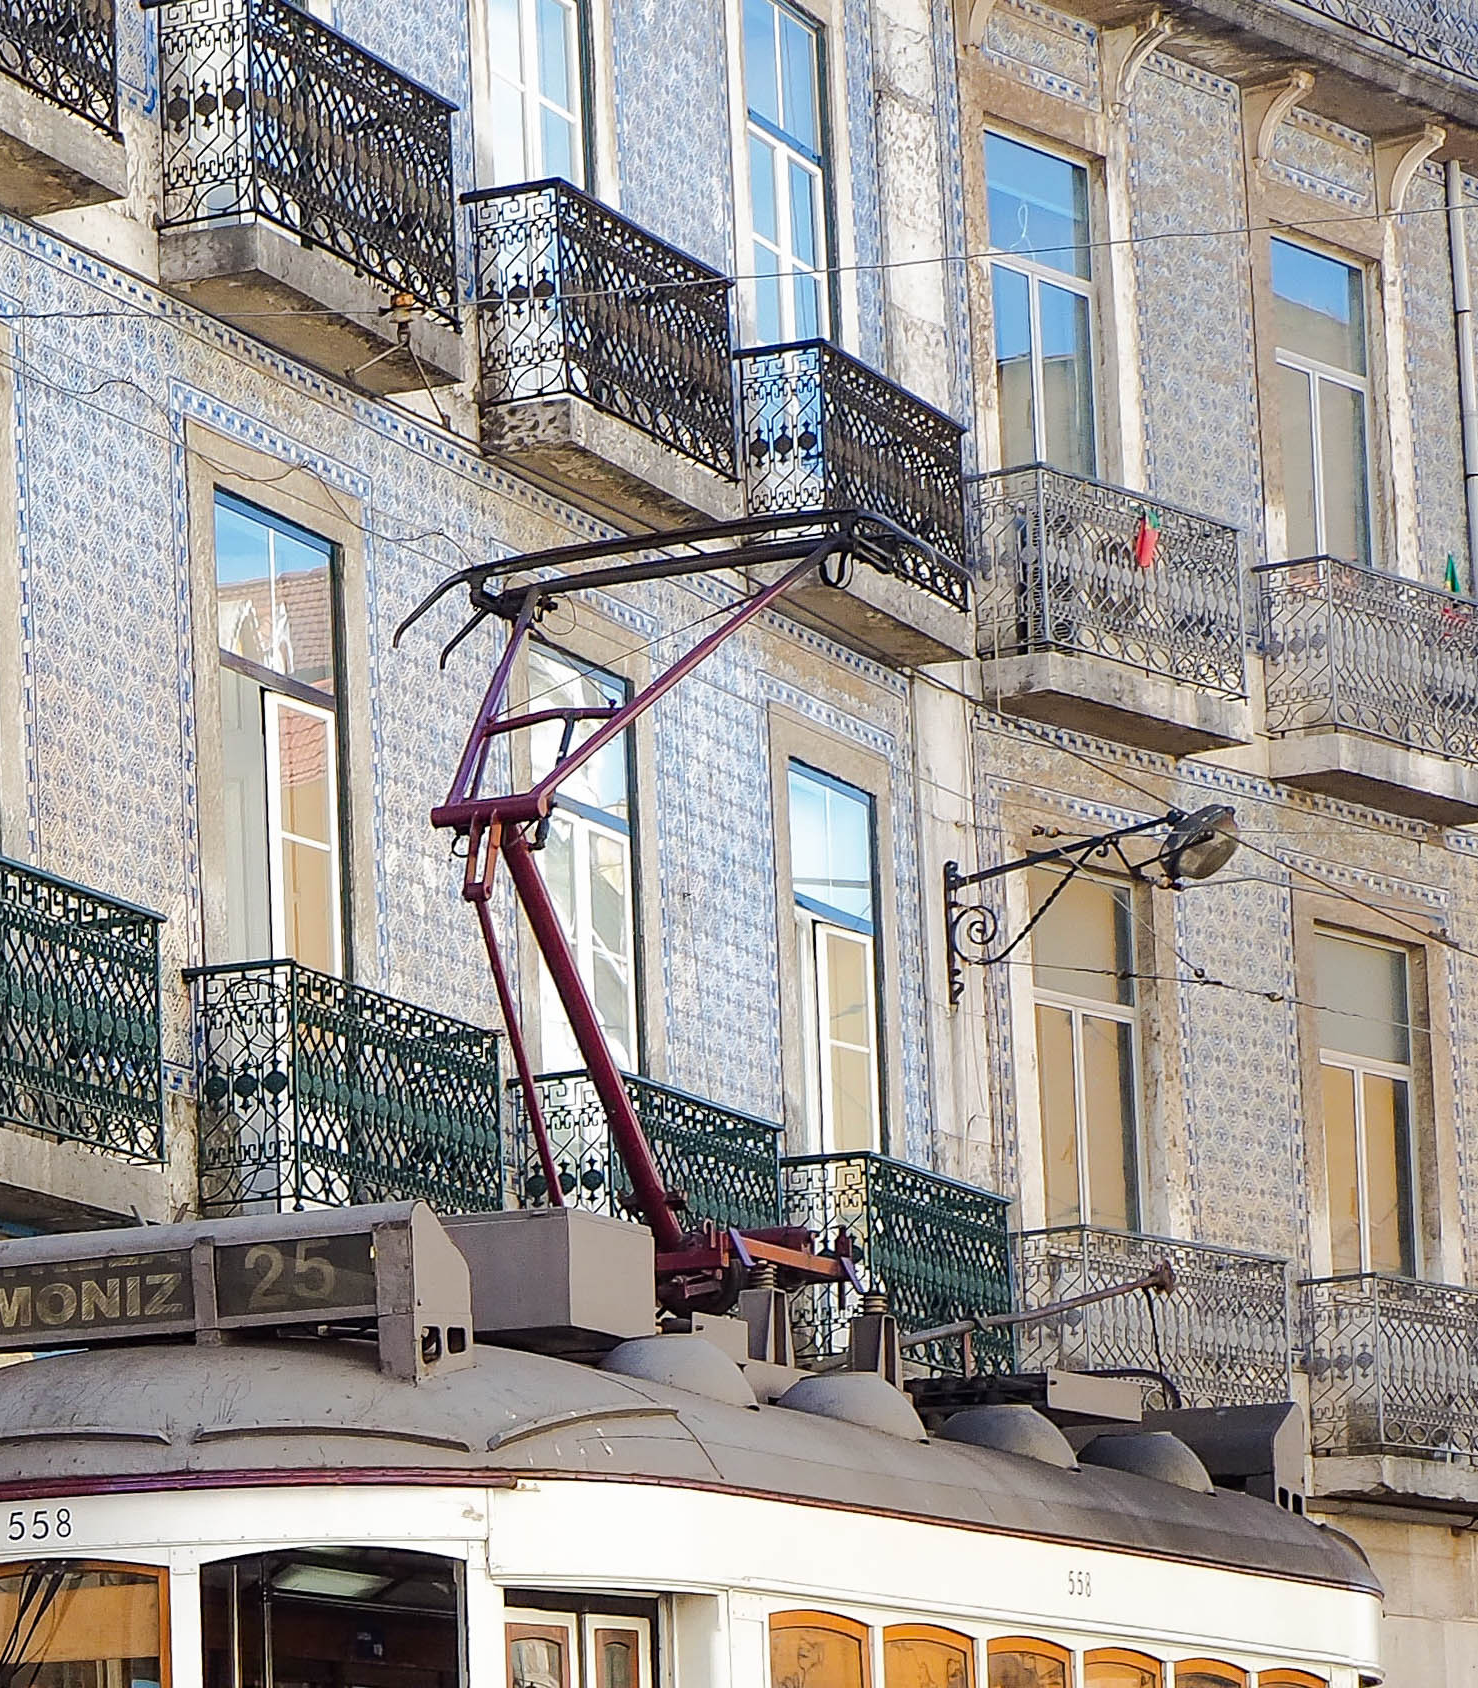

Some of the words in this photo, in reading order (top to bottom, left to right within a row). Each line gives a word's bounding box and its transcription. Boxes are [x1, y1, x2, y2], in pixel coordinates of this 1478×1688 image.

[243, 1238, 336, 1301] 25
[7, 1508, 74, 1542] 558
[1067, 1570, 1093, 1598] 558
